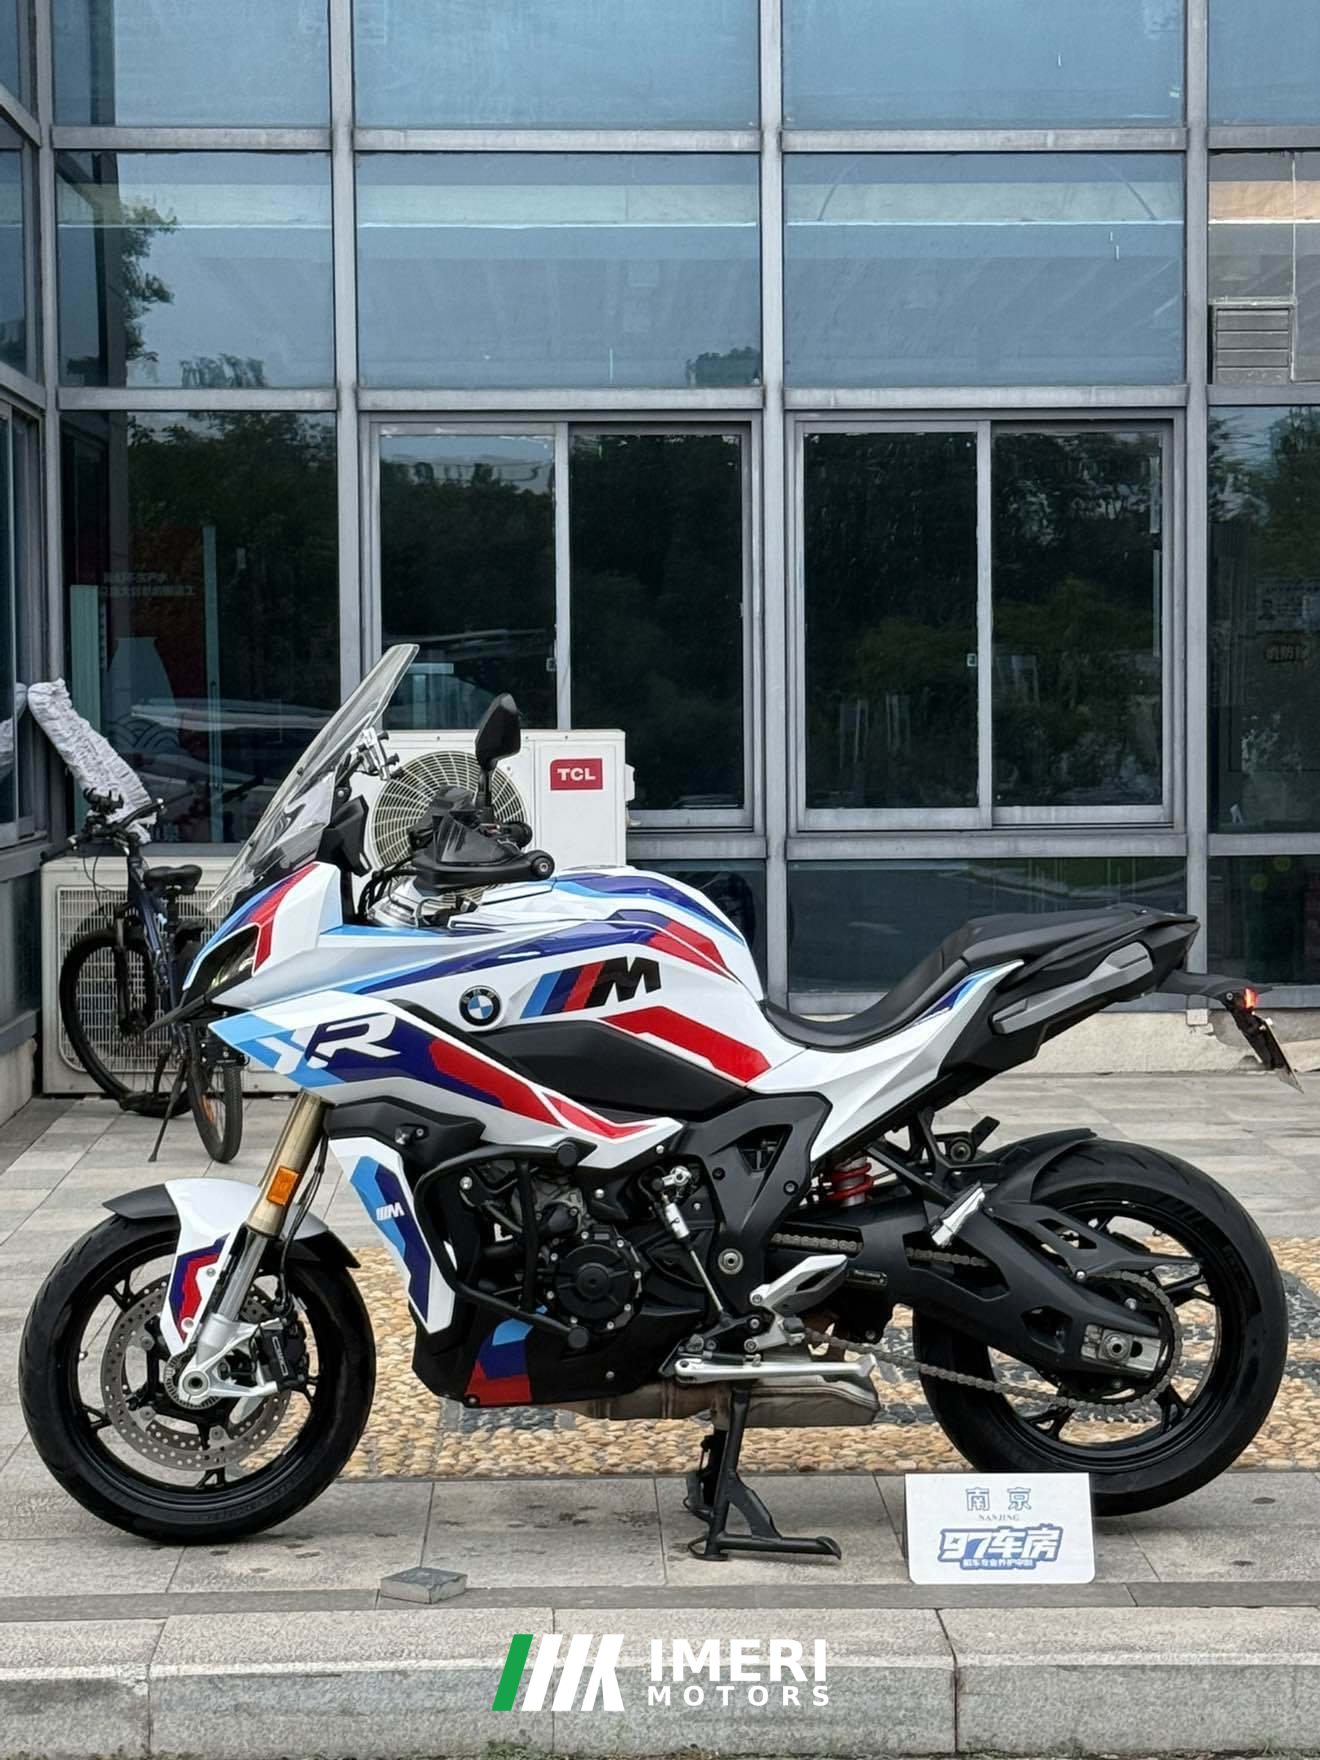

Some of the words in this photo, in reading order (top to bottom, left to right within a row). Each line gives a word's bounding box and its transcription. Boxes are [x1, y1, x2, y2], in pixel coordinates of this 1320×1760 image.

[557, 767, 596, 781] TCL
[255, 1012, 401, 1075] XR
[965, 1487, 1032, 1511] 南京
[979, 1514, 1020, 1522] NANJING
[939, 1524, 1063, 1562] 97车房
